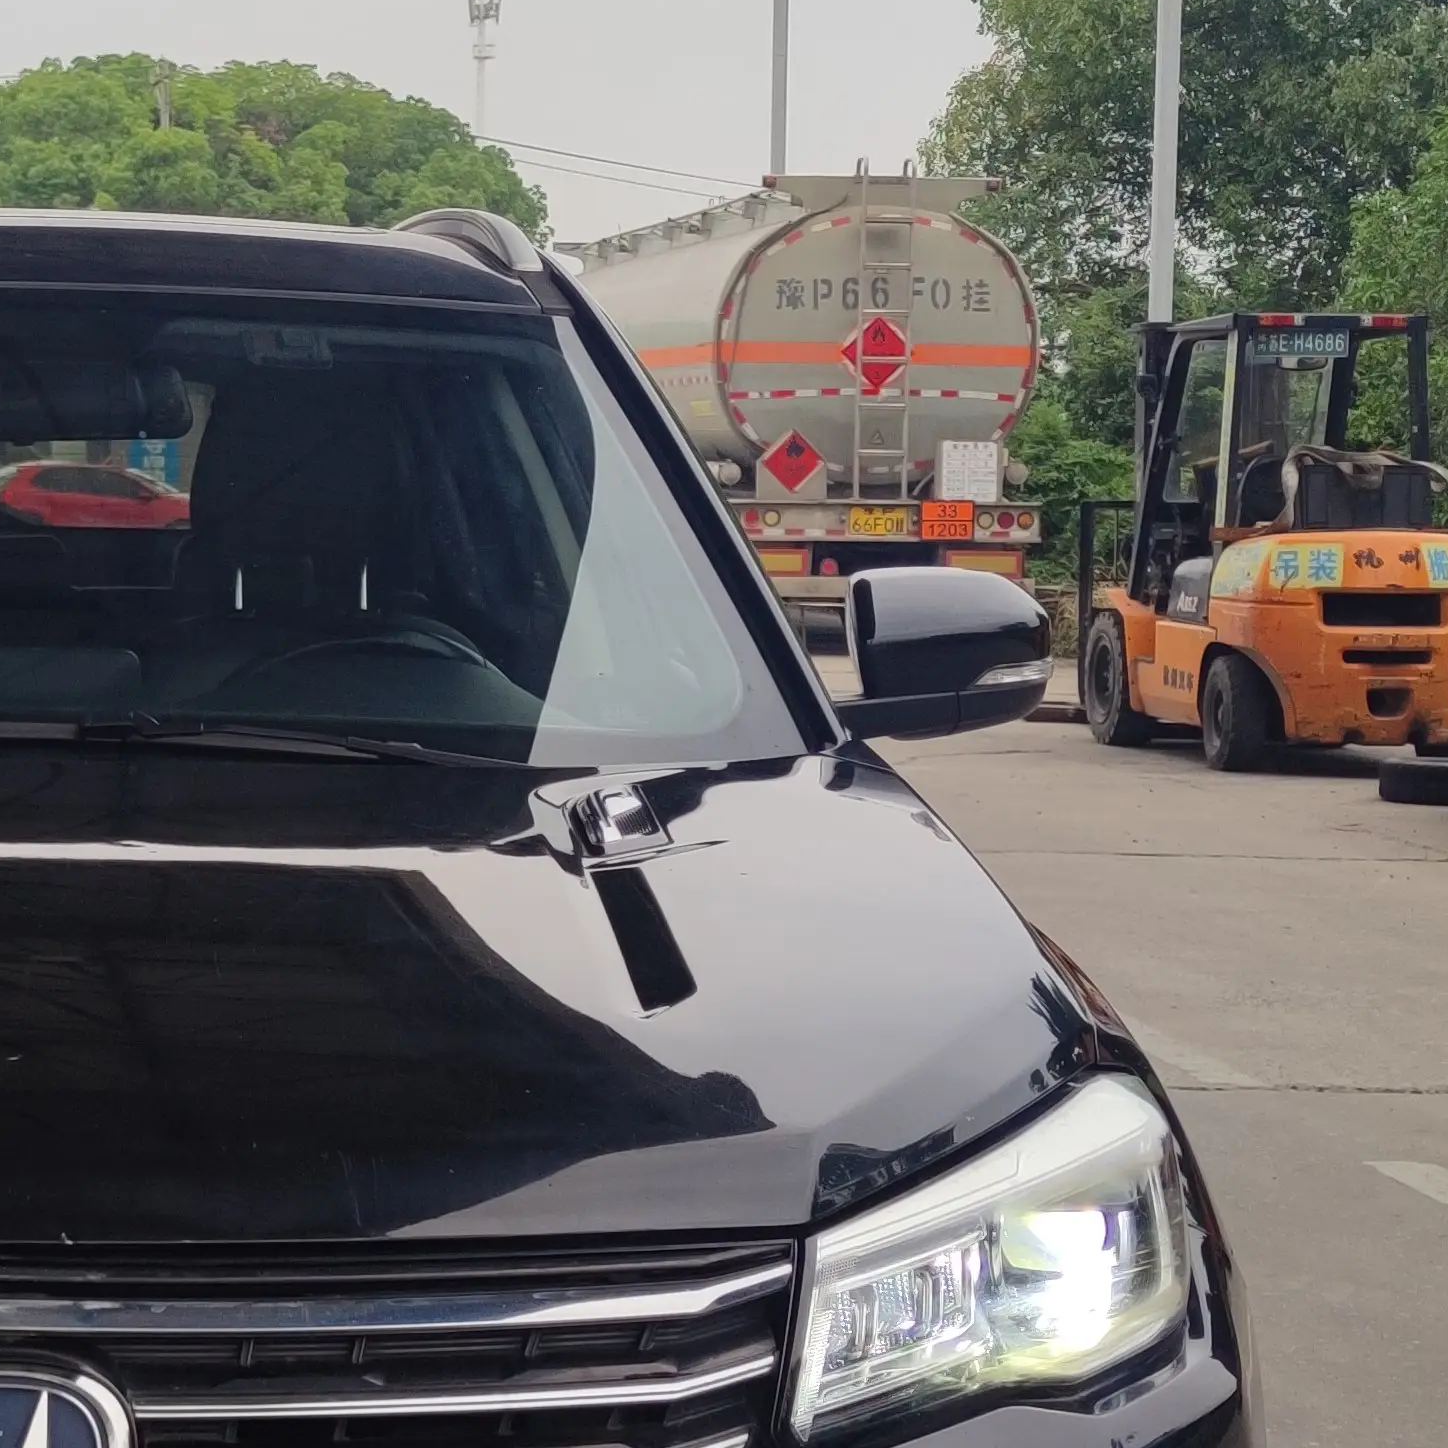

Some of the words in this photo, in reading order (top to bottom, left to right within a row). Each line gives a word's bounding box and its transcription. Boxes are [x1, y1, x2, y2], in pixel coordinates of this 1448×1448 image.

[936, 504, 958, 518] 33
[928, 523, 968, 537] 1203
[1272, 549, 1337, 581] 吊装
